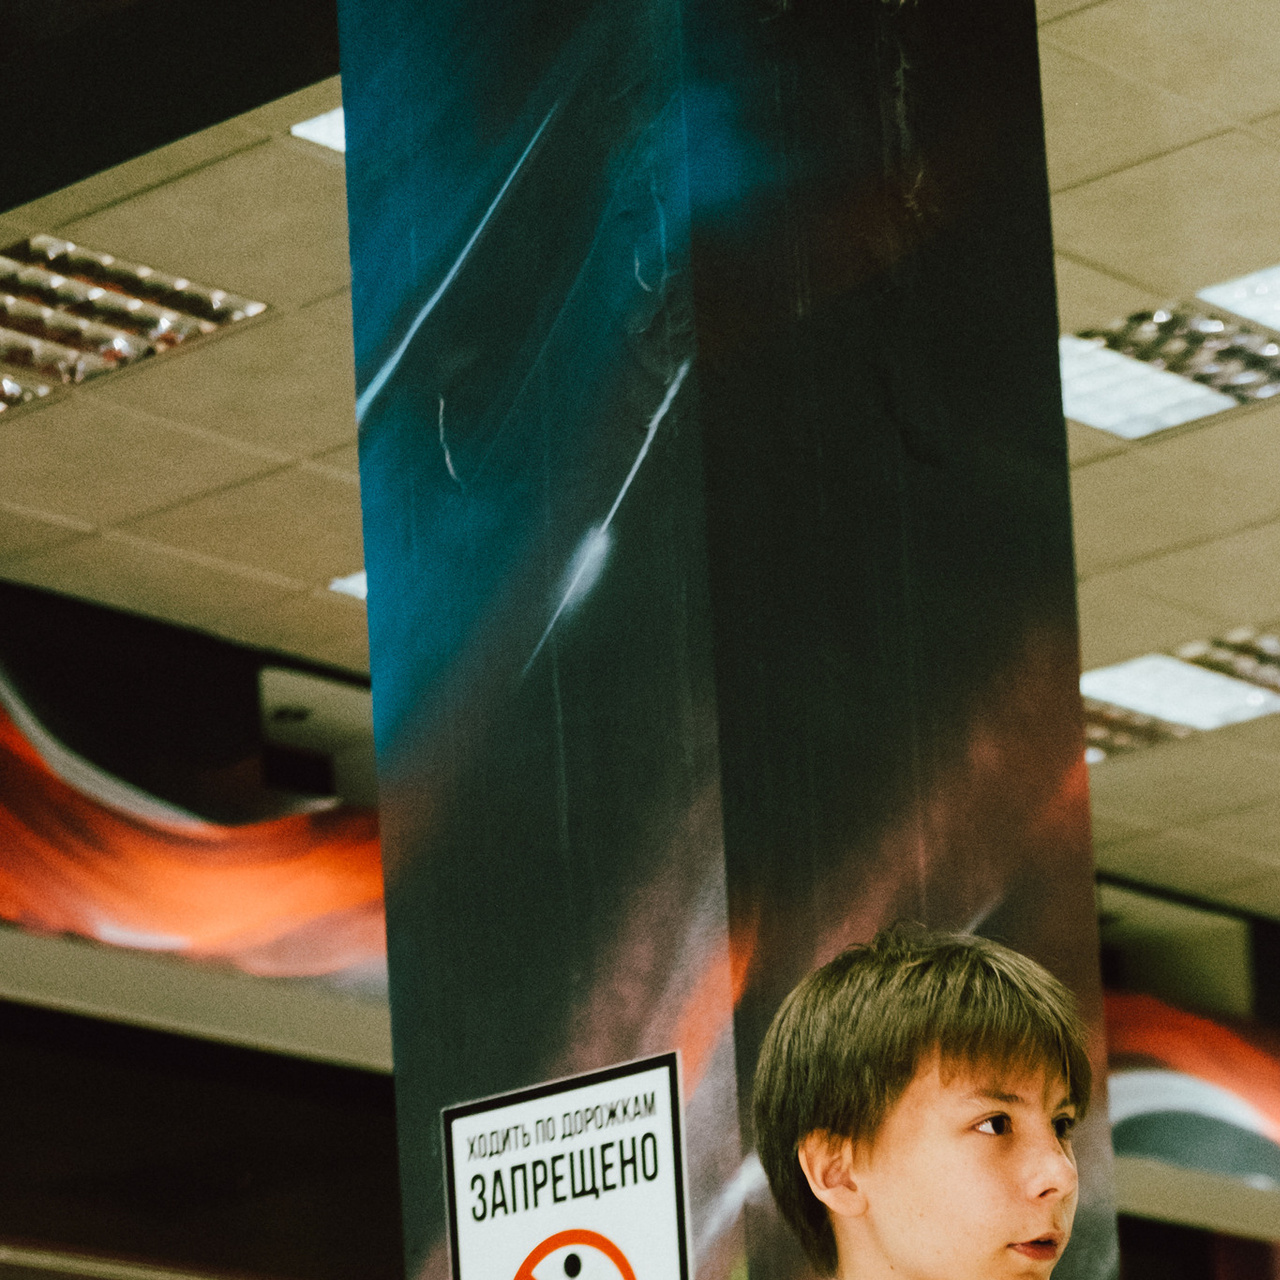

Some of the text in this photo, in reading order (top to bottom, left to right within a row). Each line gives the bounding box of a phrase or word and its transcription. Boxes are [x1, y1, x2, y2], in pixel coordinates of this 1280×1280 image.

[467, 1091, 657, 1161] ХОДИТЬ ПО ДОРОЖКАМ
[471, 1132, 659, 1222] ЗАПРЕЩЕНО
